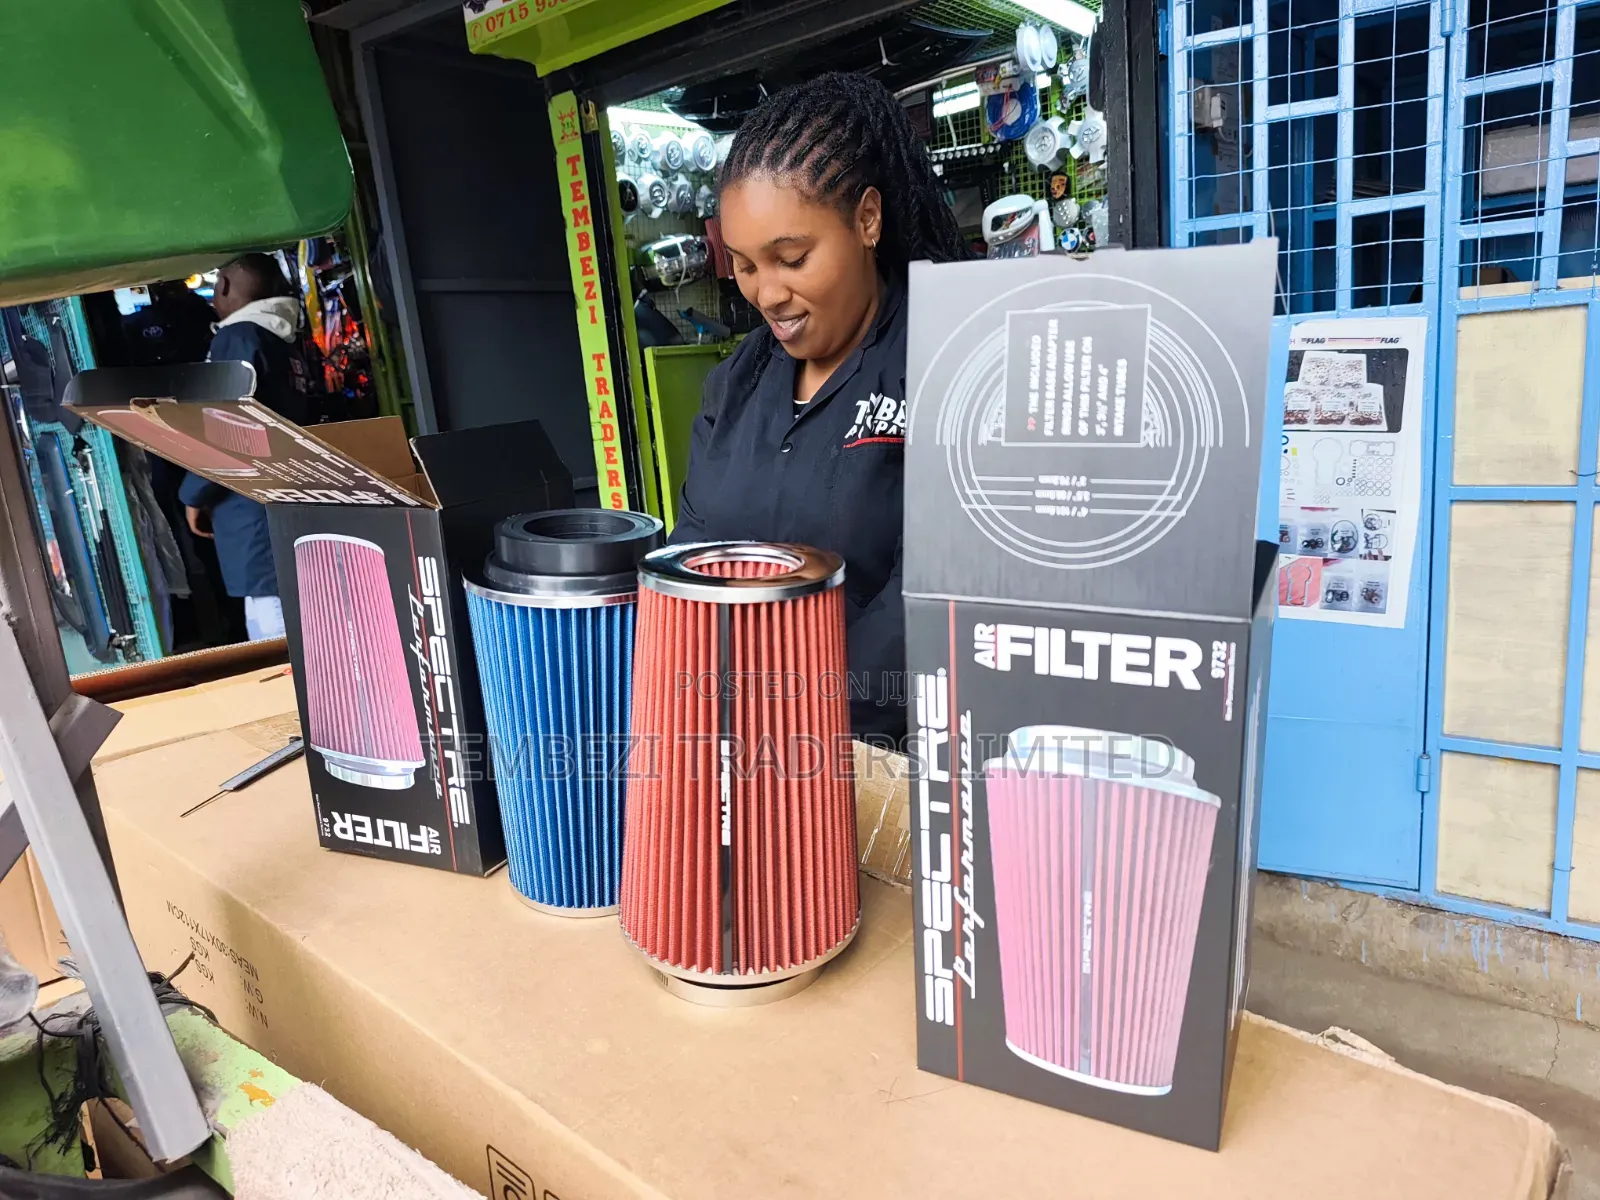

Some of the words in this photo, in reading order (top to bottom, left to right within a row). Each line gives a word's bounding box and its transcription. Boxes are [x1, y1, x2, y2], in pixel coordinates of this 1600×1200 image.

[485, 3, 529, 32] 0715
[566, 154, 598, 325] TEMBEZI
[592, 353, 623, 510] TRADERS
[1047, 318, 1059, 369] ADAPTER
[1064, 339, 1075, 362] USE
[1029, 335, 1042, 390] INCLUDED
[1080, 355, 1092, 393] FILTER
[1115, 358, 1128, 395] TUBES
[1044, 370, 1056, 399] BASE
[1062, 363, 1074, 402] ALLOW
[1097, 376, 1109, 401] AND
[1028, 391, 1039, 414] THE
[1043, 399, 1055, 436] FILTER
[1079, 394, 1090, 418] THIS
[1113, 396, 1126, 436] INTAKE
[973, 622, 996, 670] AIR
[996, 623, 1203, 691] FILTER
[1210, 640, 1228, 680] 9732
[408, 583, 443, 800] Performance
[417, 556, 471, 826] SPECTRE
[322, 817, 332, 838] 9732
[330, 811, 431, 854] FILTER
[428, 826, 442, 855] AIR
[916, 667, 955, 1026] SPECTRE
[953, 709, 985, 1000] Performance
[189, 936, 210, 962] KGS
[194, 958, 215, 984] KGS
